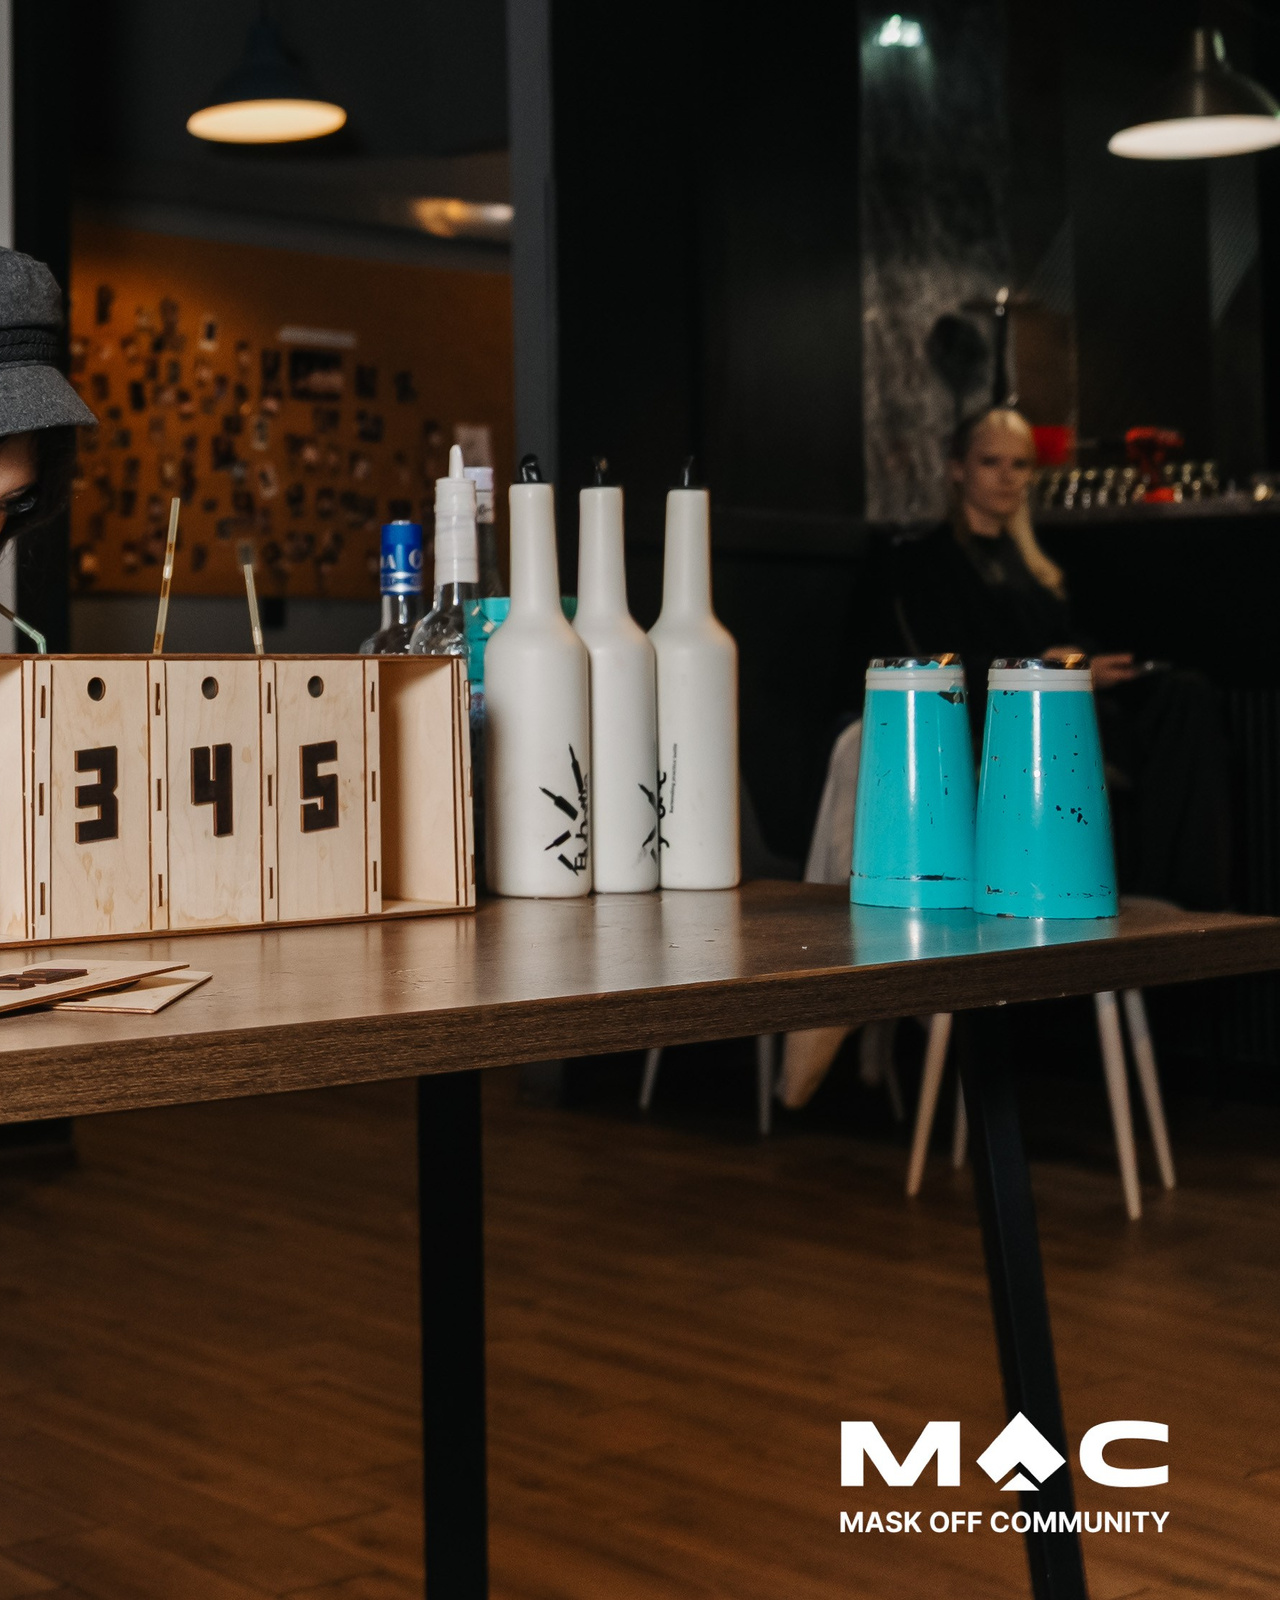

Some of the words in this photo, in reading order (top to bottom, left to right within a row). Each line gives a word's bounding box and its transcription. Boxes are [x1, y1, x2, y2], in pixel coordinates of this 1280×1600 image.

[74, 745, 119, 844] 3
[190, 743, 233, 838] 4
[298, 740, 339, 833] 5
